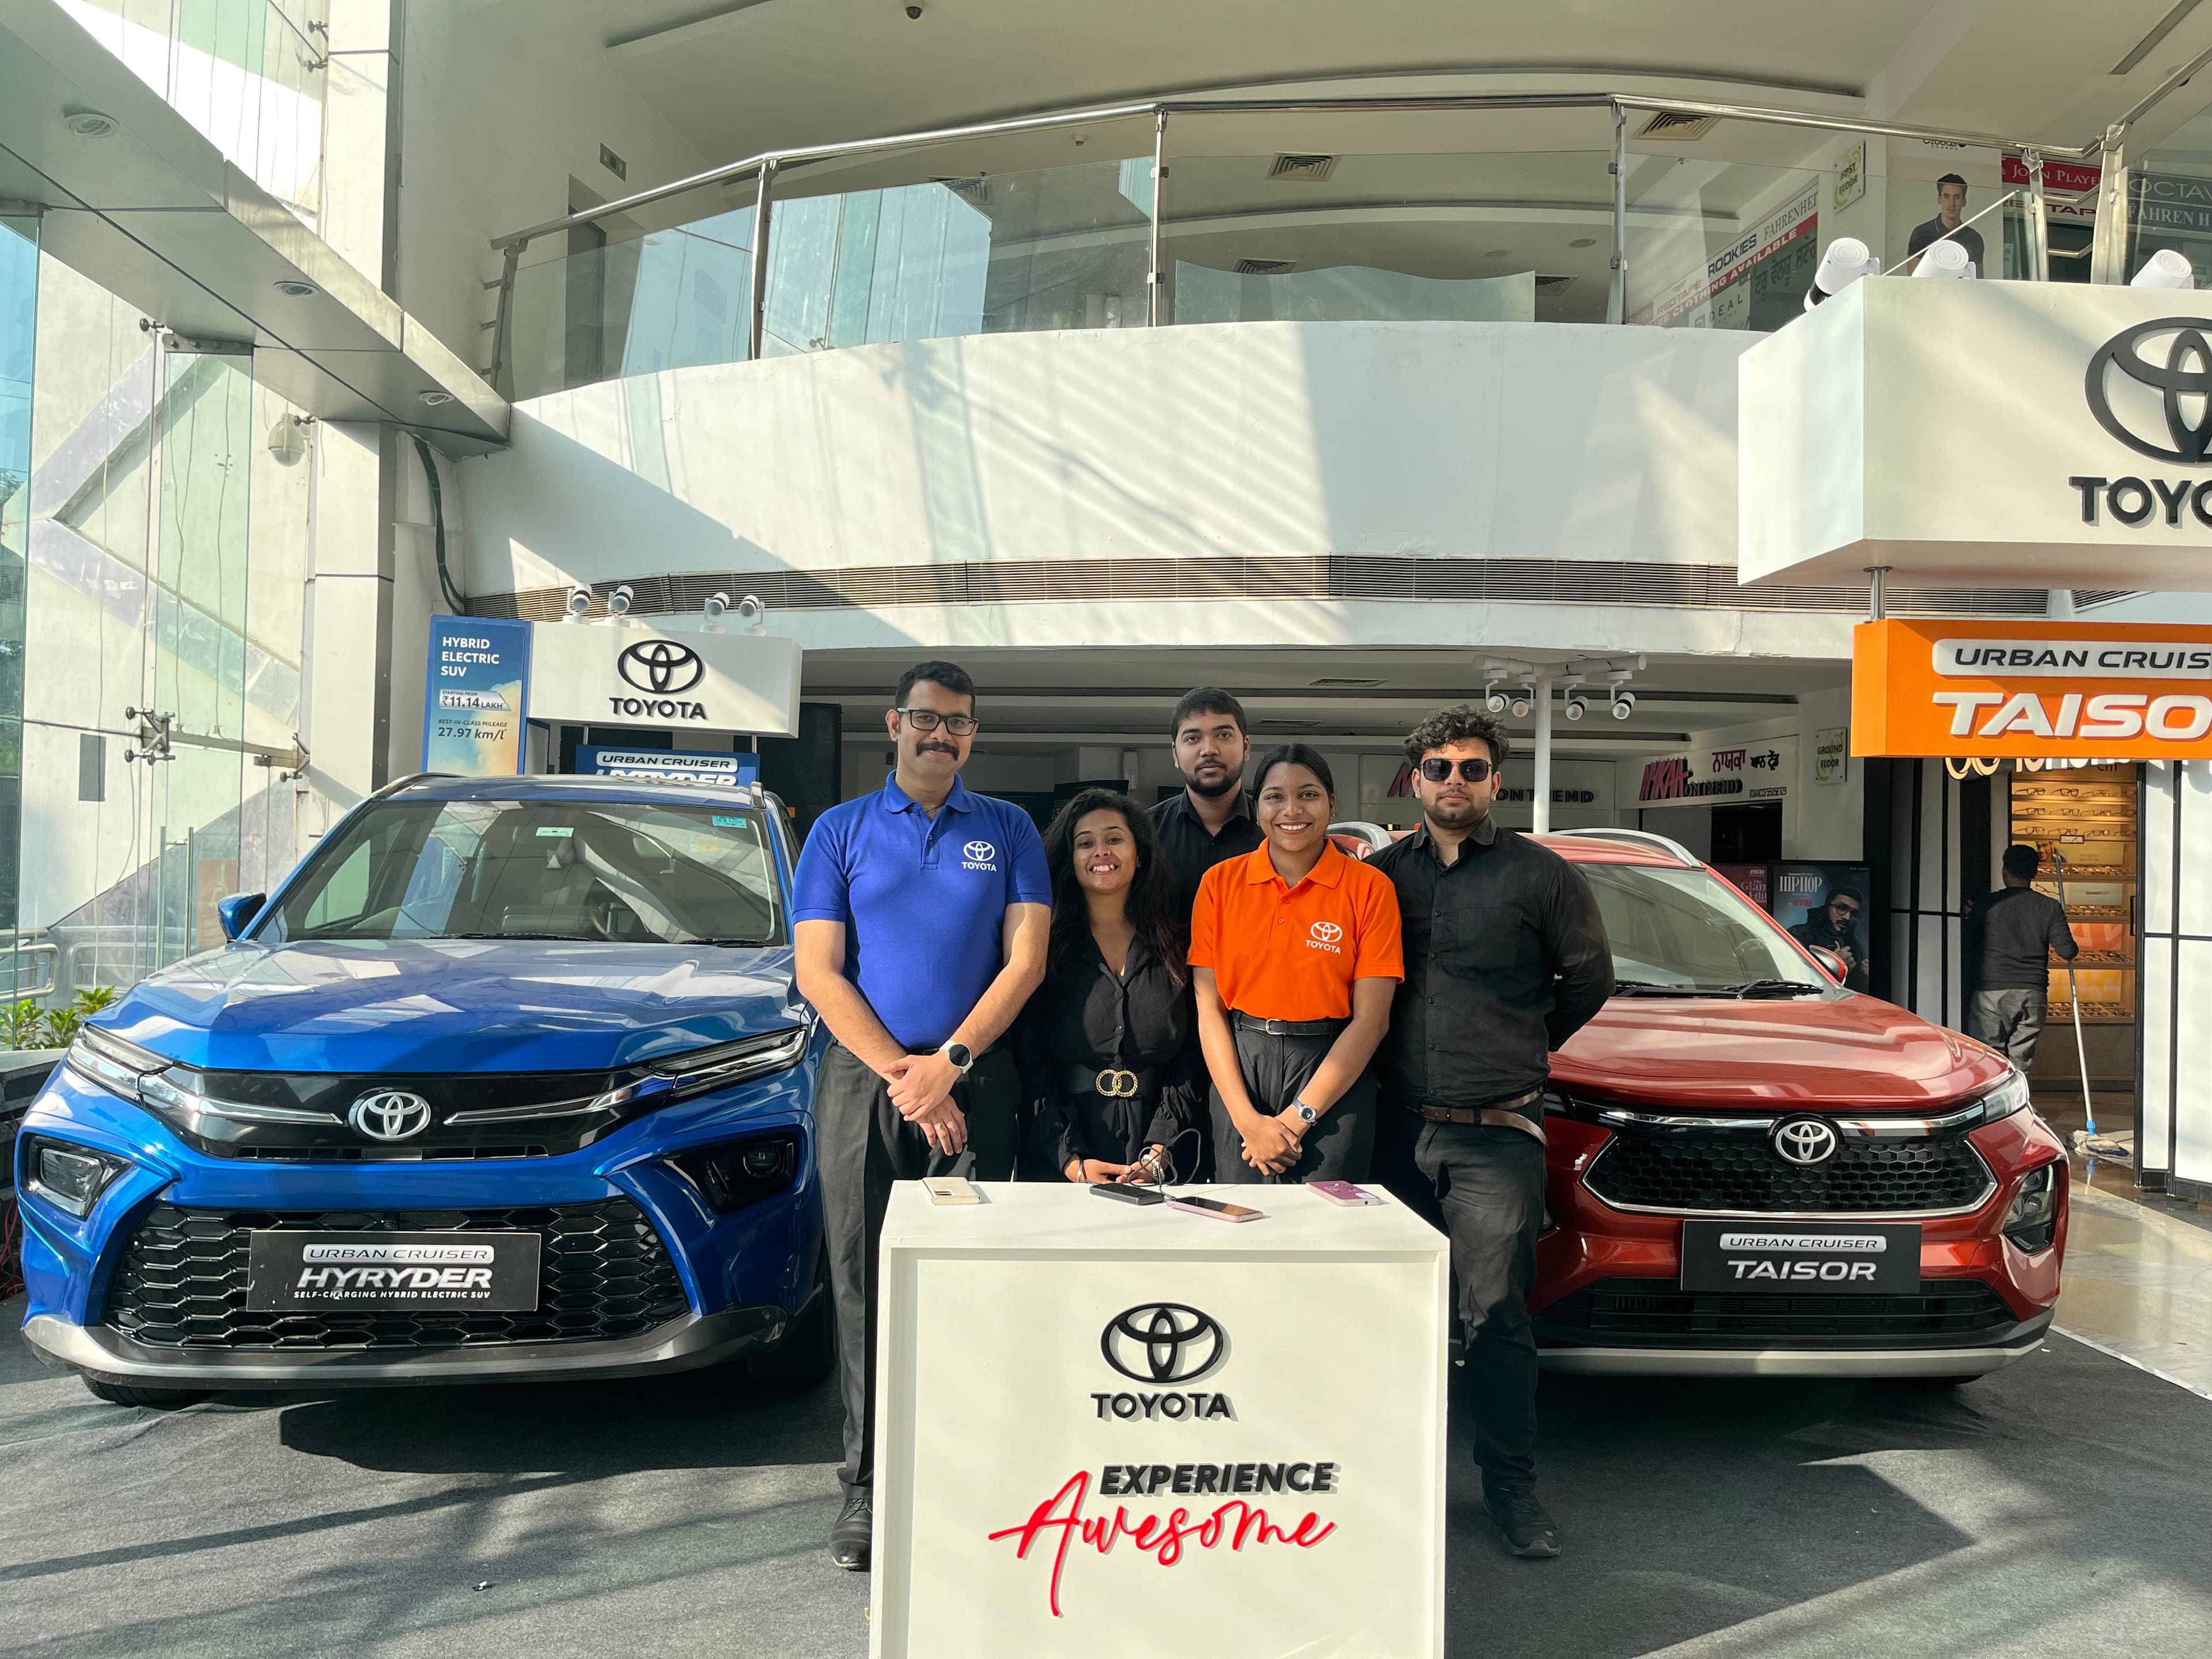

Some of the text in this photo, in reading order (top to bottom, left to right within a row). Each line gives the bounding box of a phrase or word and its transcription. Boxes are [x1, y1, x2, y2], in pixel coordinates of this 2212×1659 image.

[2012, 165, 2050, 180] JON
[2057, 170, 2100, 185] PLAYE
[1839, 175, 1858, 195] FLOOR
[1708, 233, 1757, 278] ROOKIES
[1673, 276, 1727, 317] CLOTHING
[1730, 228, 1797, 280] AVAILABLE
[1710, 294, 1744, 322] DEAL
[442, 637, 490, 649] HYBRID
[442, 651, 500, 664] ELECTRIC
[1955, 648, 2089, 668] URBAN
[441, 665, 467, 677] SUV
[609, 697, 709, 721] TOYOTA
[438, 727, 472, 738] 27.97
[1817, 744, 1843, 755] GROUND
[603, 755, 730, 768] URBAN CRUISER
[1820, 759, 1840, 768] FLOOR
[1527, 789, 1594, 803] TEND
[961, 861, 997, 872] TOYOTA
[1779, 876, 1823, 892] HIPHOP
[1305, 940, 1341, 955] TOYOTA
[1730, 1238, 1877, 1249] URBAN CRUISER
[310, 1249, 488, 1259] URBAN CRUISER
[296, 1267, 494, 1289] HYRYDER
[1727, 1260, 1877, 1281] TAISOR
[294, 1290, 491, 1300] SELF-CHARGING HYBRID ELECTRIC SUV
[1090, 1393, 1233, 1419] TOYOTA
[1100, 1461, 1335, 1496] EXPERIENCE
[988, 1470, 1338, 1616] Awesome
